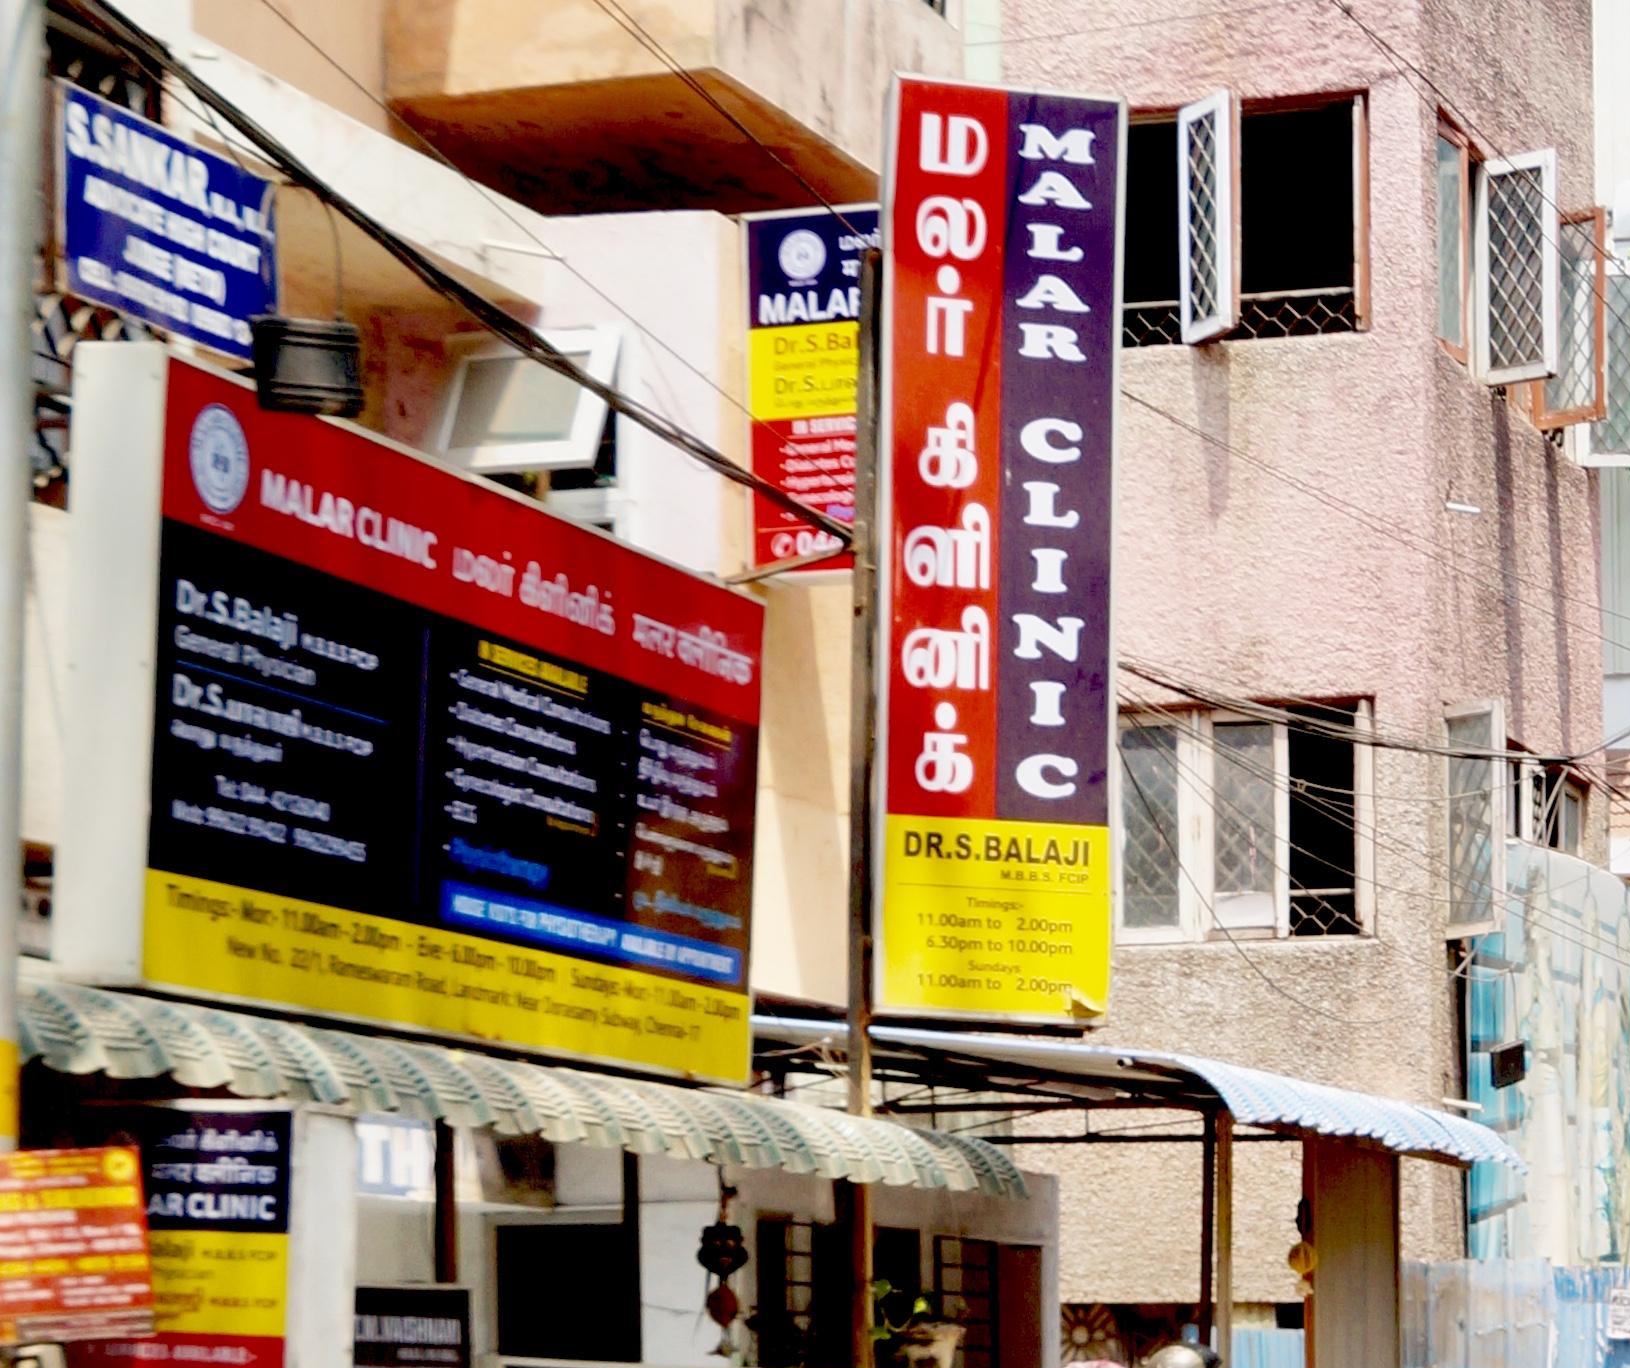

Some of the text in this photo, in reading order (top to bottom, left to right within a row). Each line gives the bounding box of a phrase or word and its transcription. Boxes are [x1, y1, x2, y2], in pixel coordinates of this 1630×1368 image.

[915, 111, 990, 358] மலர்
[1015, 123, 1096, 362] MALAR
[260, 468, 438, 569] MALAR CLINIC
[452, 547, 516, 597] மலர்
[176, 579, 298, 650] Dr.S.Balaji
[901, 401, 991, 794] கிளினிக்
[1013, 417, 1085, 799] CLINIC
[904, 831, 1090, 867] DR.S.BALAJI
[1058, 872, 1089, 884] FCIP
[917, 913, 1073, 934] 11.00am to 2.00pm
[926, 935, 1073, 956] 6.30pm to 10.00pm
[967, 960, 1021, 974] Sundays
[917, 973, 1073, 995] 11.00am to 2.00pm
[186, 1194, 277, 1221] CLINIC
